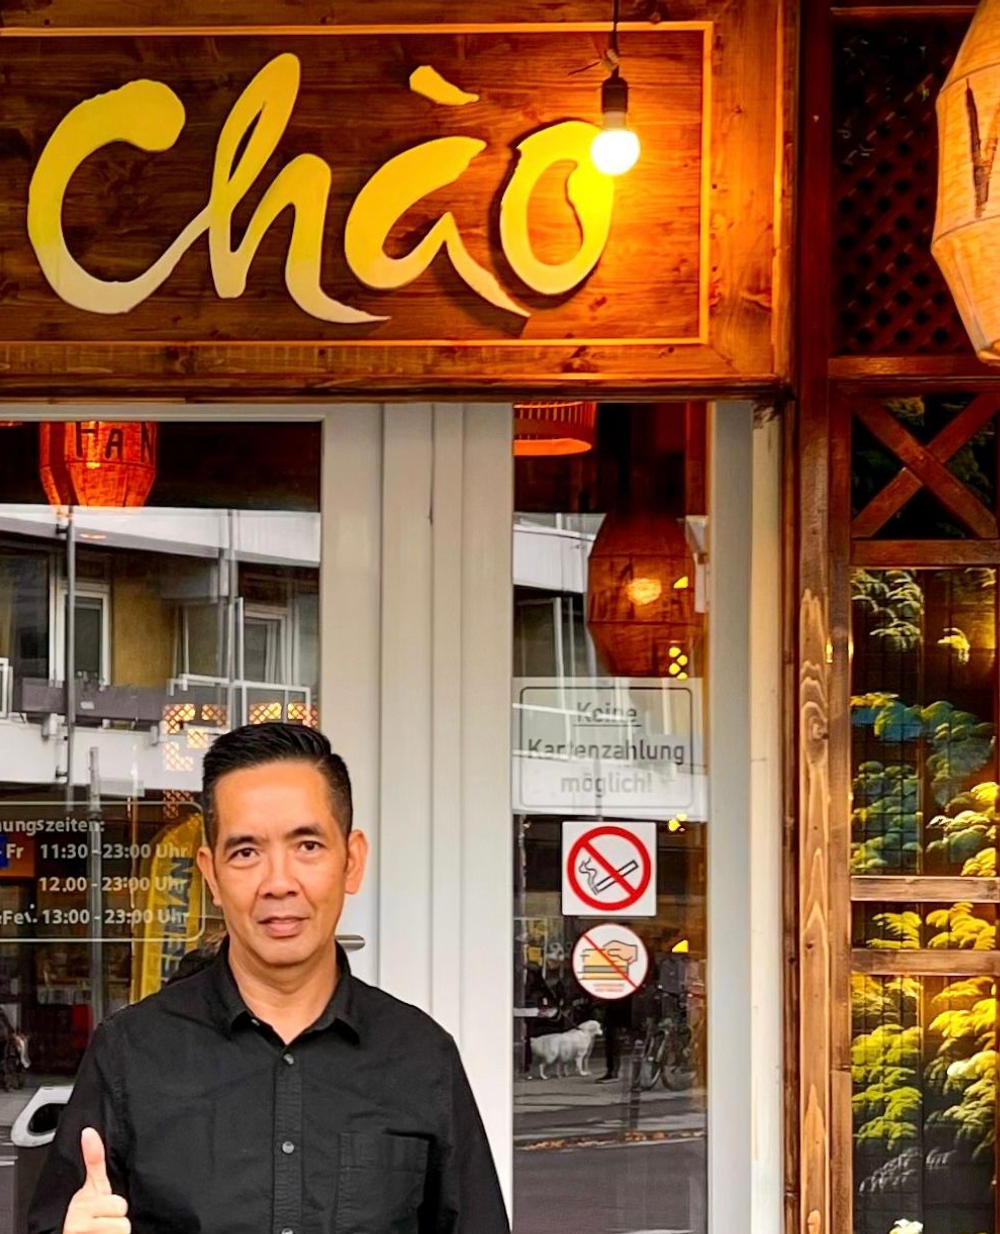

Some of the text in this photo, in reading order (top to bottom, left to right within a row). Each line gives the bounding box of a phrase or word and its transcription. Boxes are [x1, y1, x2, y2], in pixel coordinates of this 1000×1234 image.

[27, 53, 614, 324] Chào
[577, 702, 638, 723] Keine
[560, 772, 652, 798] möglich!
[6, 843, 24, 859] Fr
[40, 843, 88, 859] 11:30
[103, 843, 151, 859] 23:00
[155, 842, 189, 858] Uhr
[101, 877, 150, 891] 23:00
[155, 876, 187, 892] Uhr
[42, 909, 90, 924] 13:00
[104, 909, 153, 924] 23:00
[158, 908, 190, 924] Uhr
